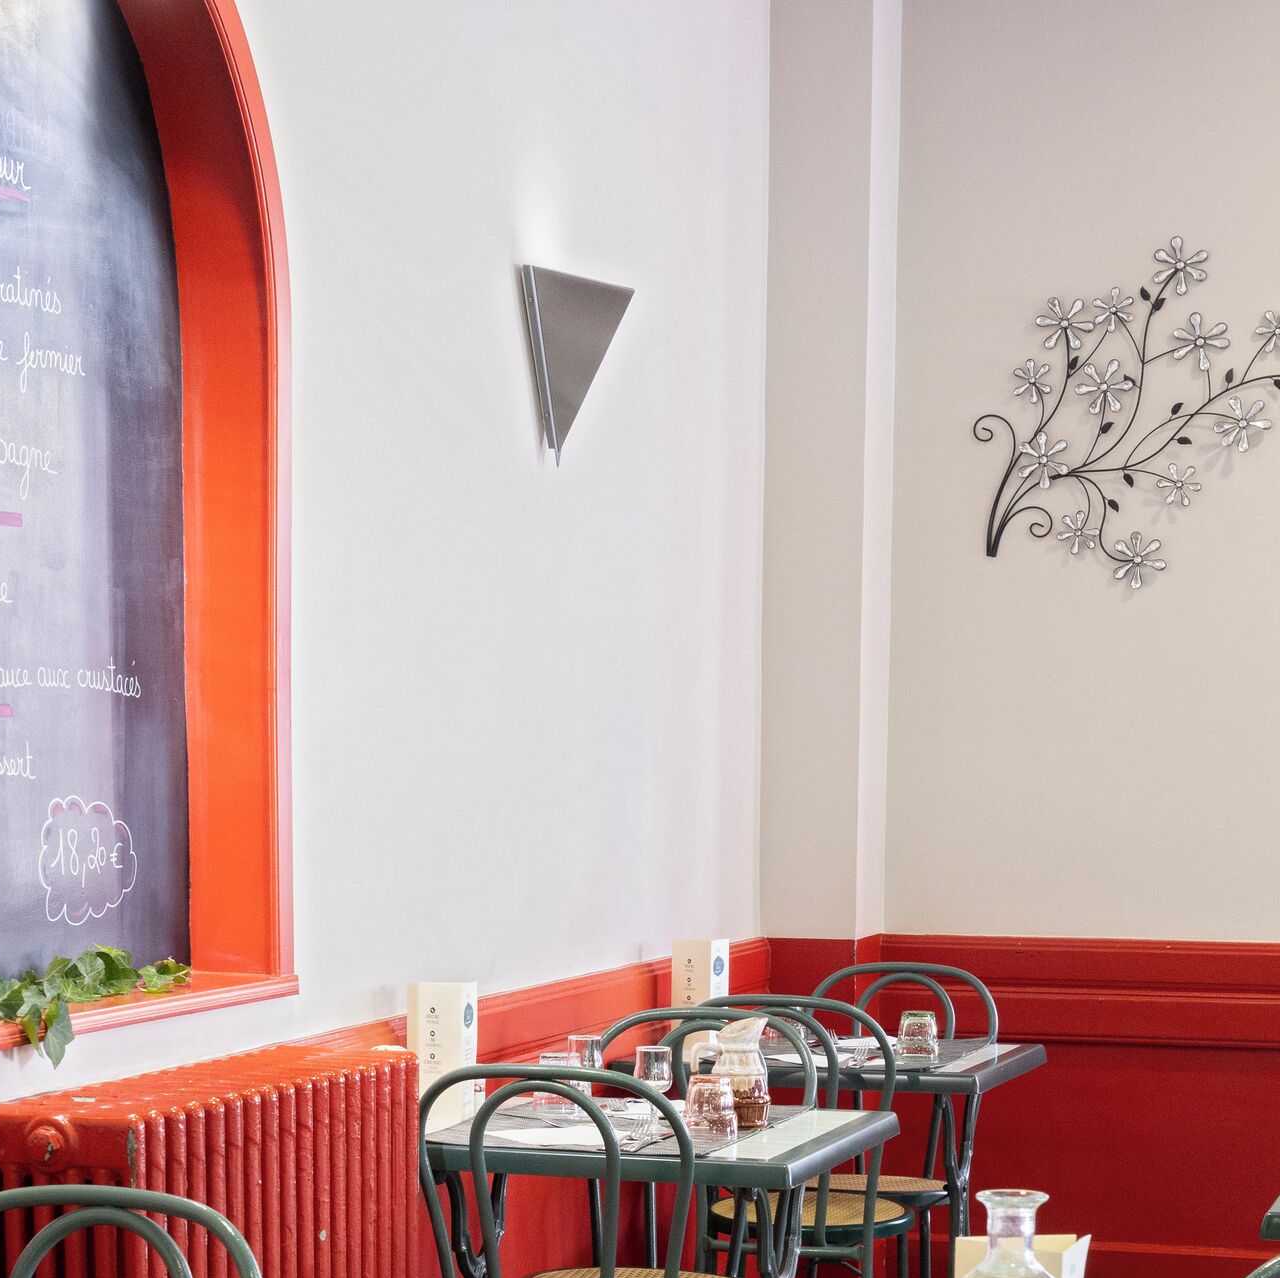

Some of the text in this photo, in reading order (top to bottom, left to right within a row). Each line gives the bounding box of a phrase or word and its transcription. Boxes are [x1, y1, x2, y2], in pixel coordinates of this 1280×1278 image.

[16, 332, 87, 393] fermier
[37, 666, 71, 689] aux
[77, 656, 142, 699] crustacés
